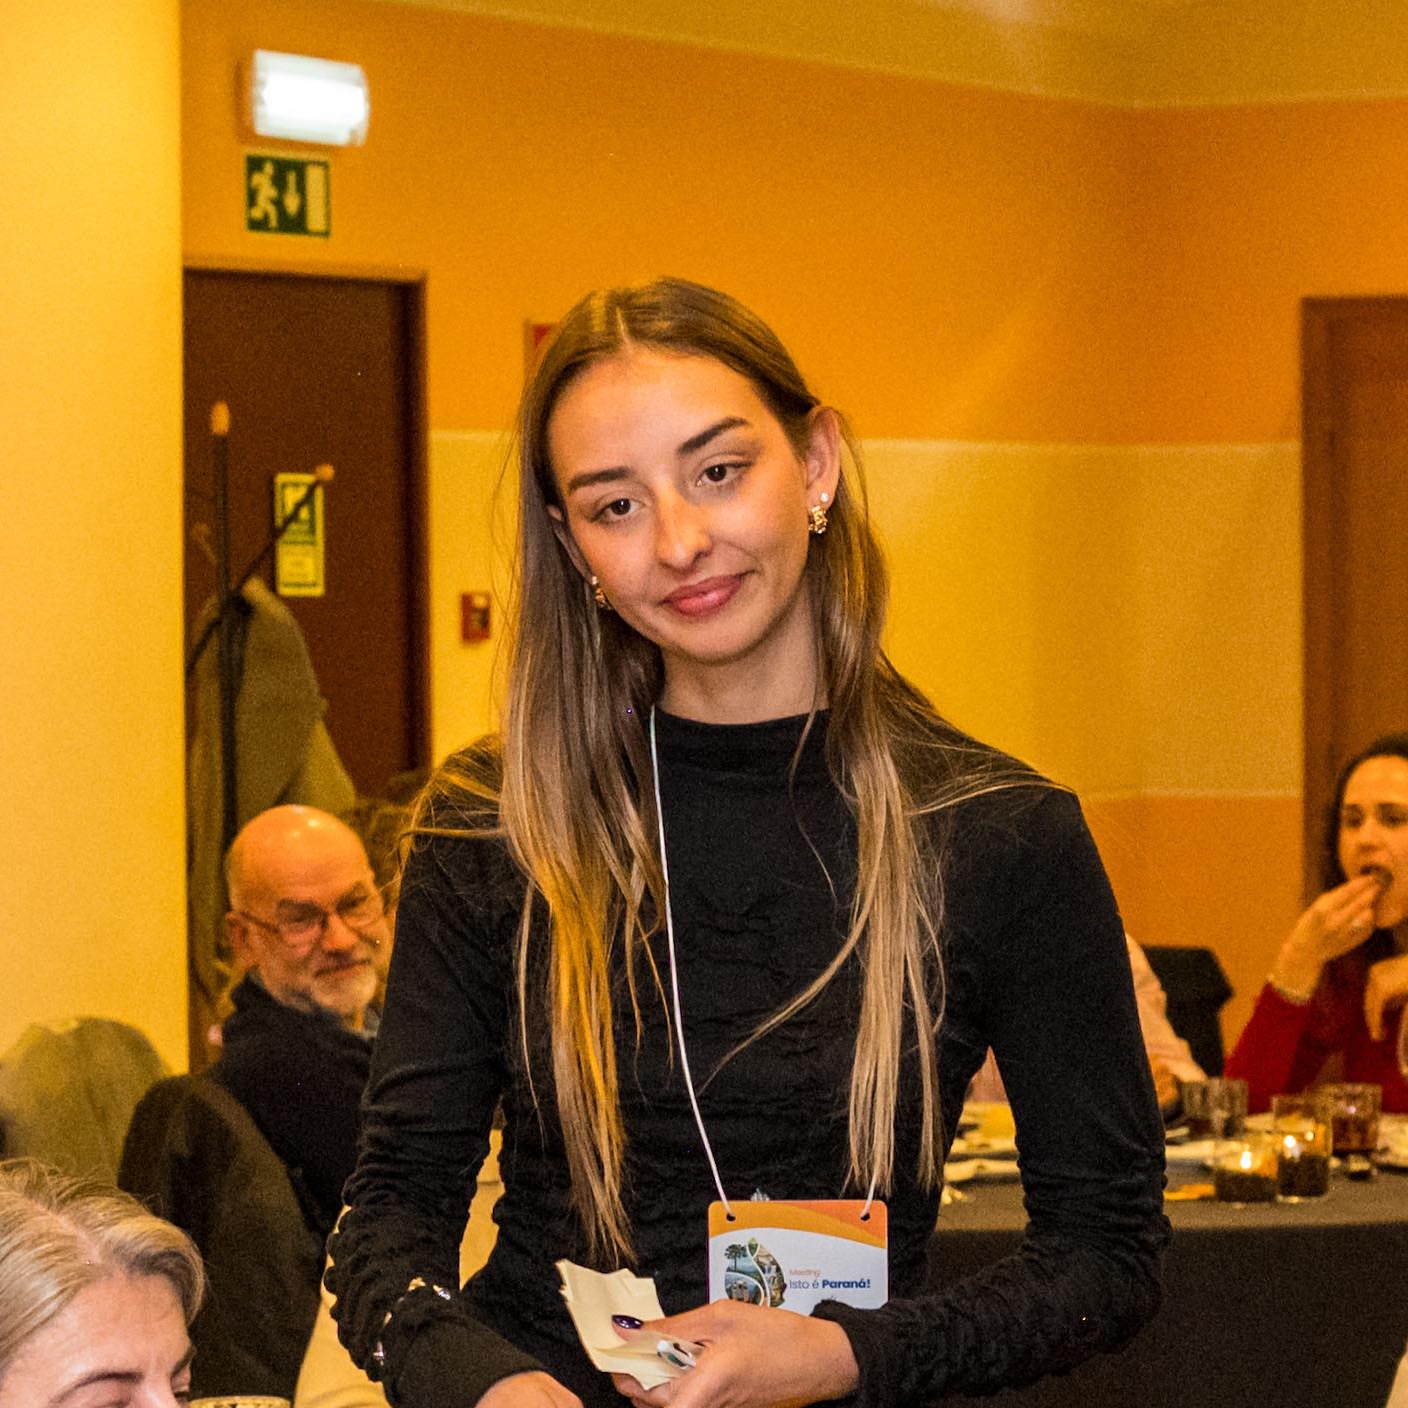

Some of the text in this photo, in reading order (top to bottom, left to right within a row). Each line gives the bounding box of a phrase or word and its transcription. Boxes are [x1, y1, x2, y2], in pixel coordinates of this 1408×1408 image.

[789, 1278, 871, 1289] Isto é Paraná!
